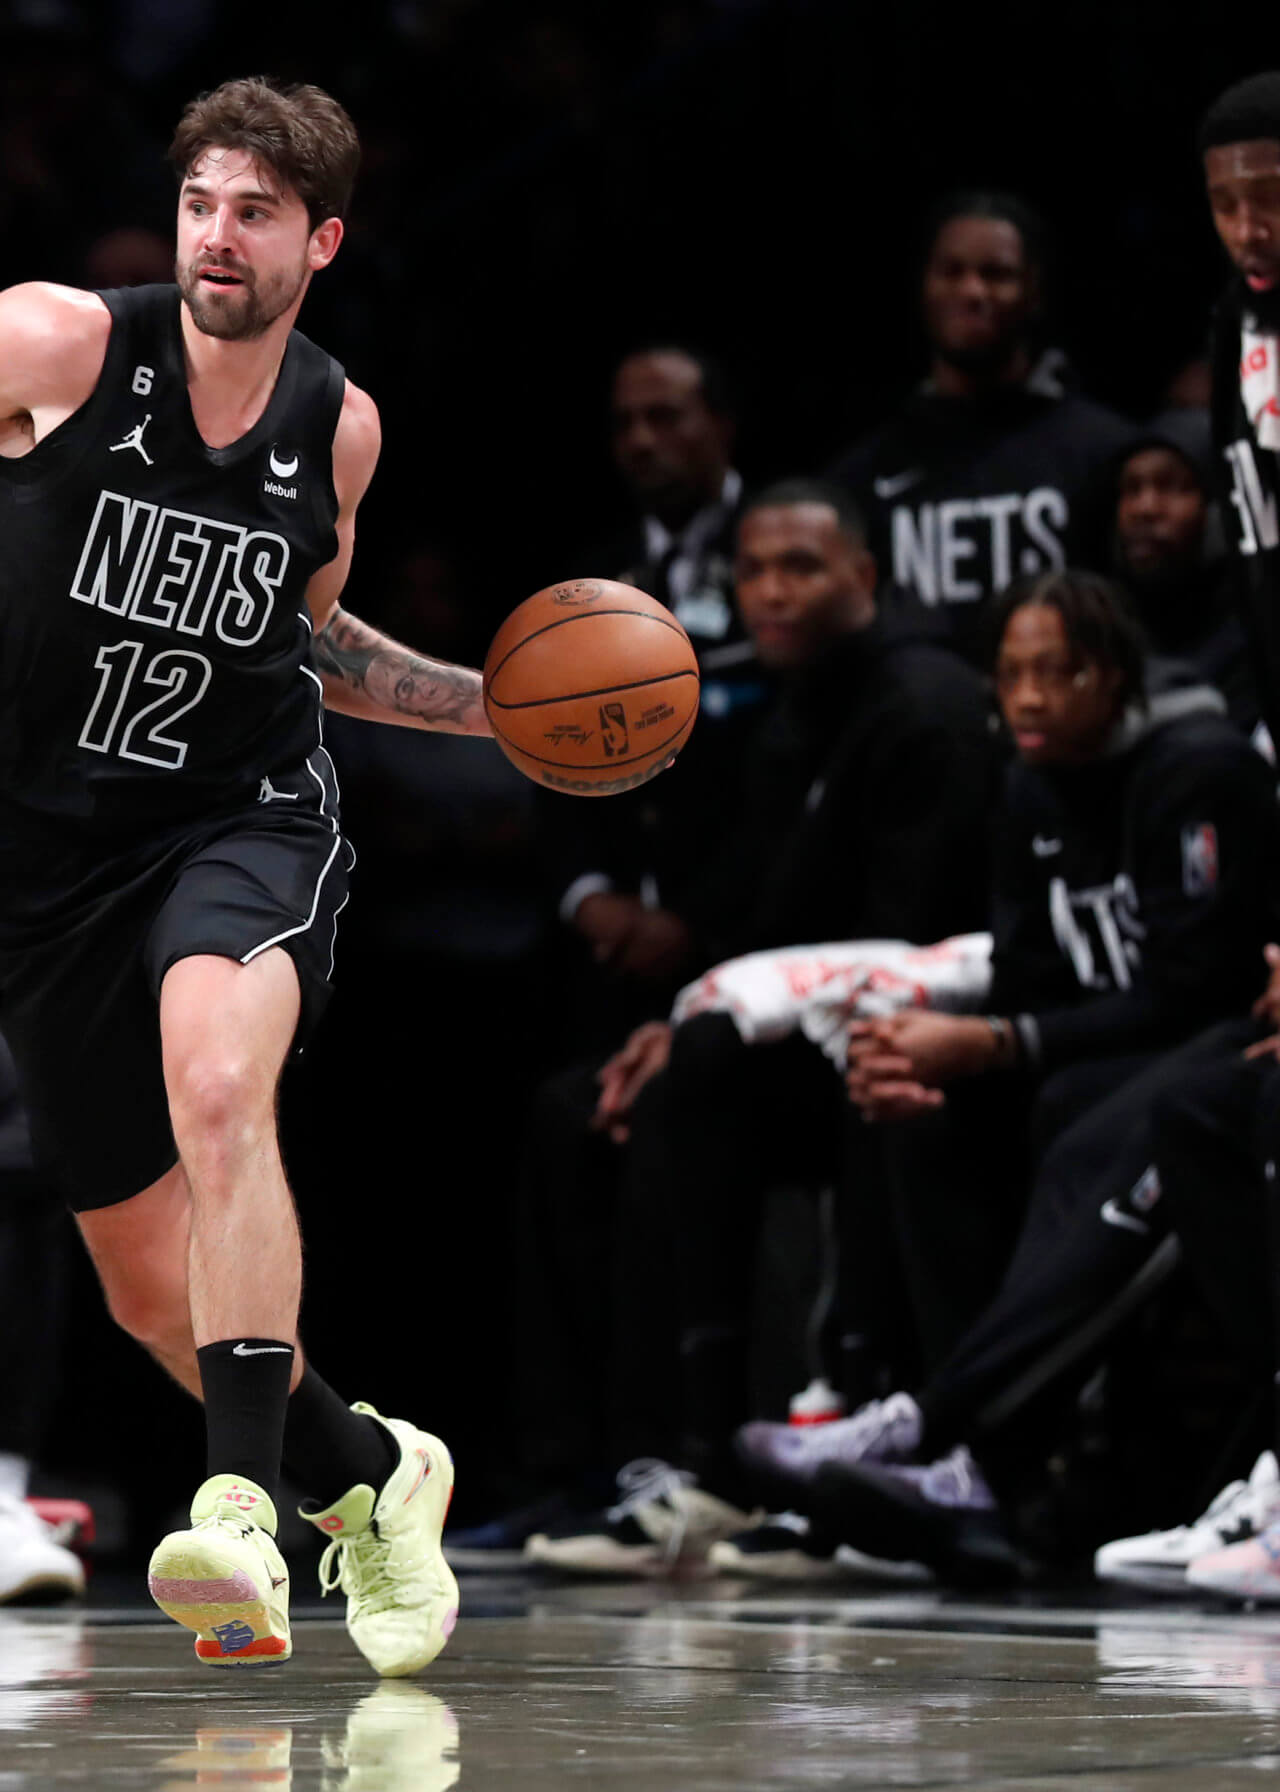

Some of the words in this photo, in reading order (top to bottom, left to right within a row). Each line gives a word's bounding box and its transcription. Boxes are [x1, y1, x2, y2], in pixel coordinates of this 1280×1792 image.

[131, 365, 155, 396] 6
[263, 480, 297, 500] Webull
[889, 486, 1070, 607] NETS
[69, 489, 291, 647] NETS
[77, 639, 213, 769] 12
